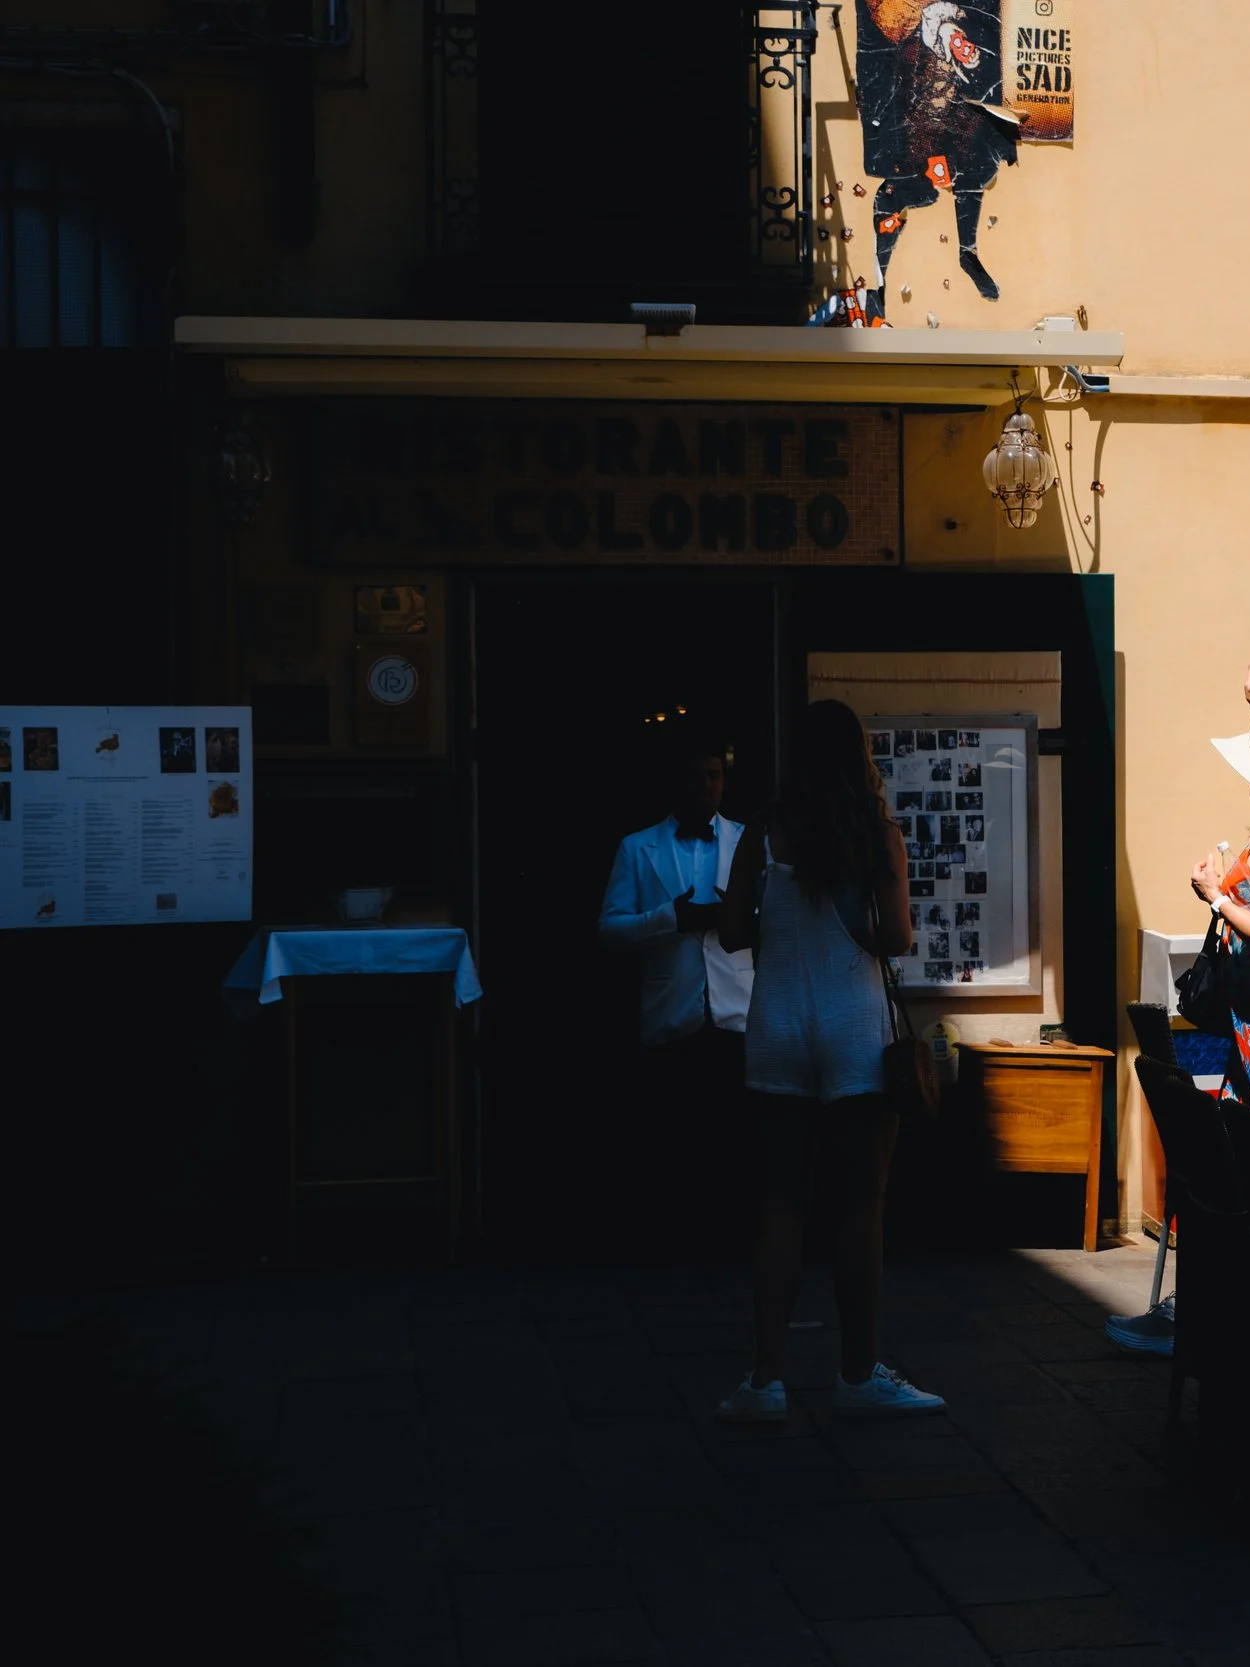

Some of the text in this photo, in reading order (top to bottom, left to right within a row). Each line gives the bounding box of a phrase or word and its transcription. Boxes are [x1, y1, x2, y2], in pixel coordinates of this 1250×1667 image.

[1017, 27, 1071, 51] NICE
[1016, 51, 1071, 64] PICTURES
[1016, 63, 1072, 92] SAD
[1016, 94, 1071, 105] GENERATION
[492, 489, 851, 551] COLOMBO
